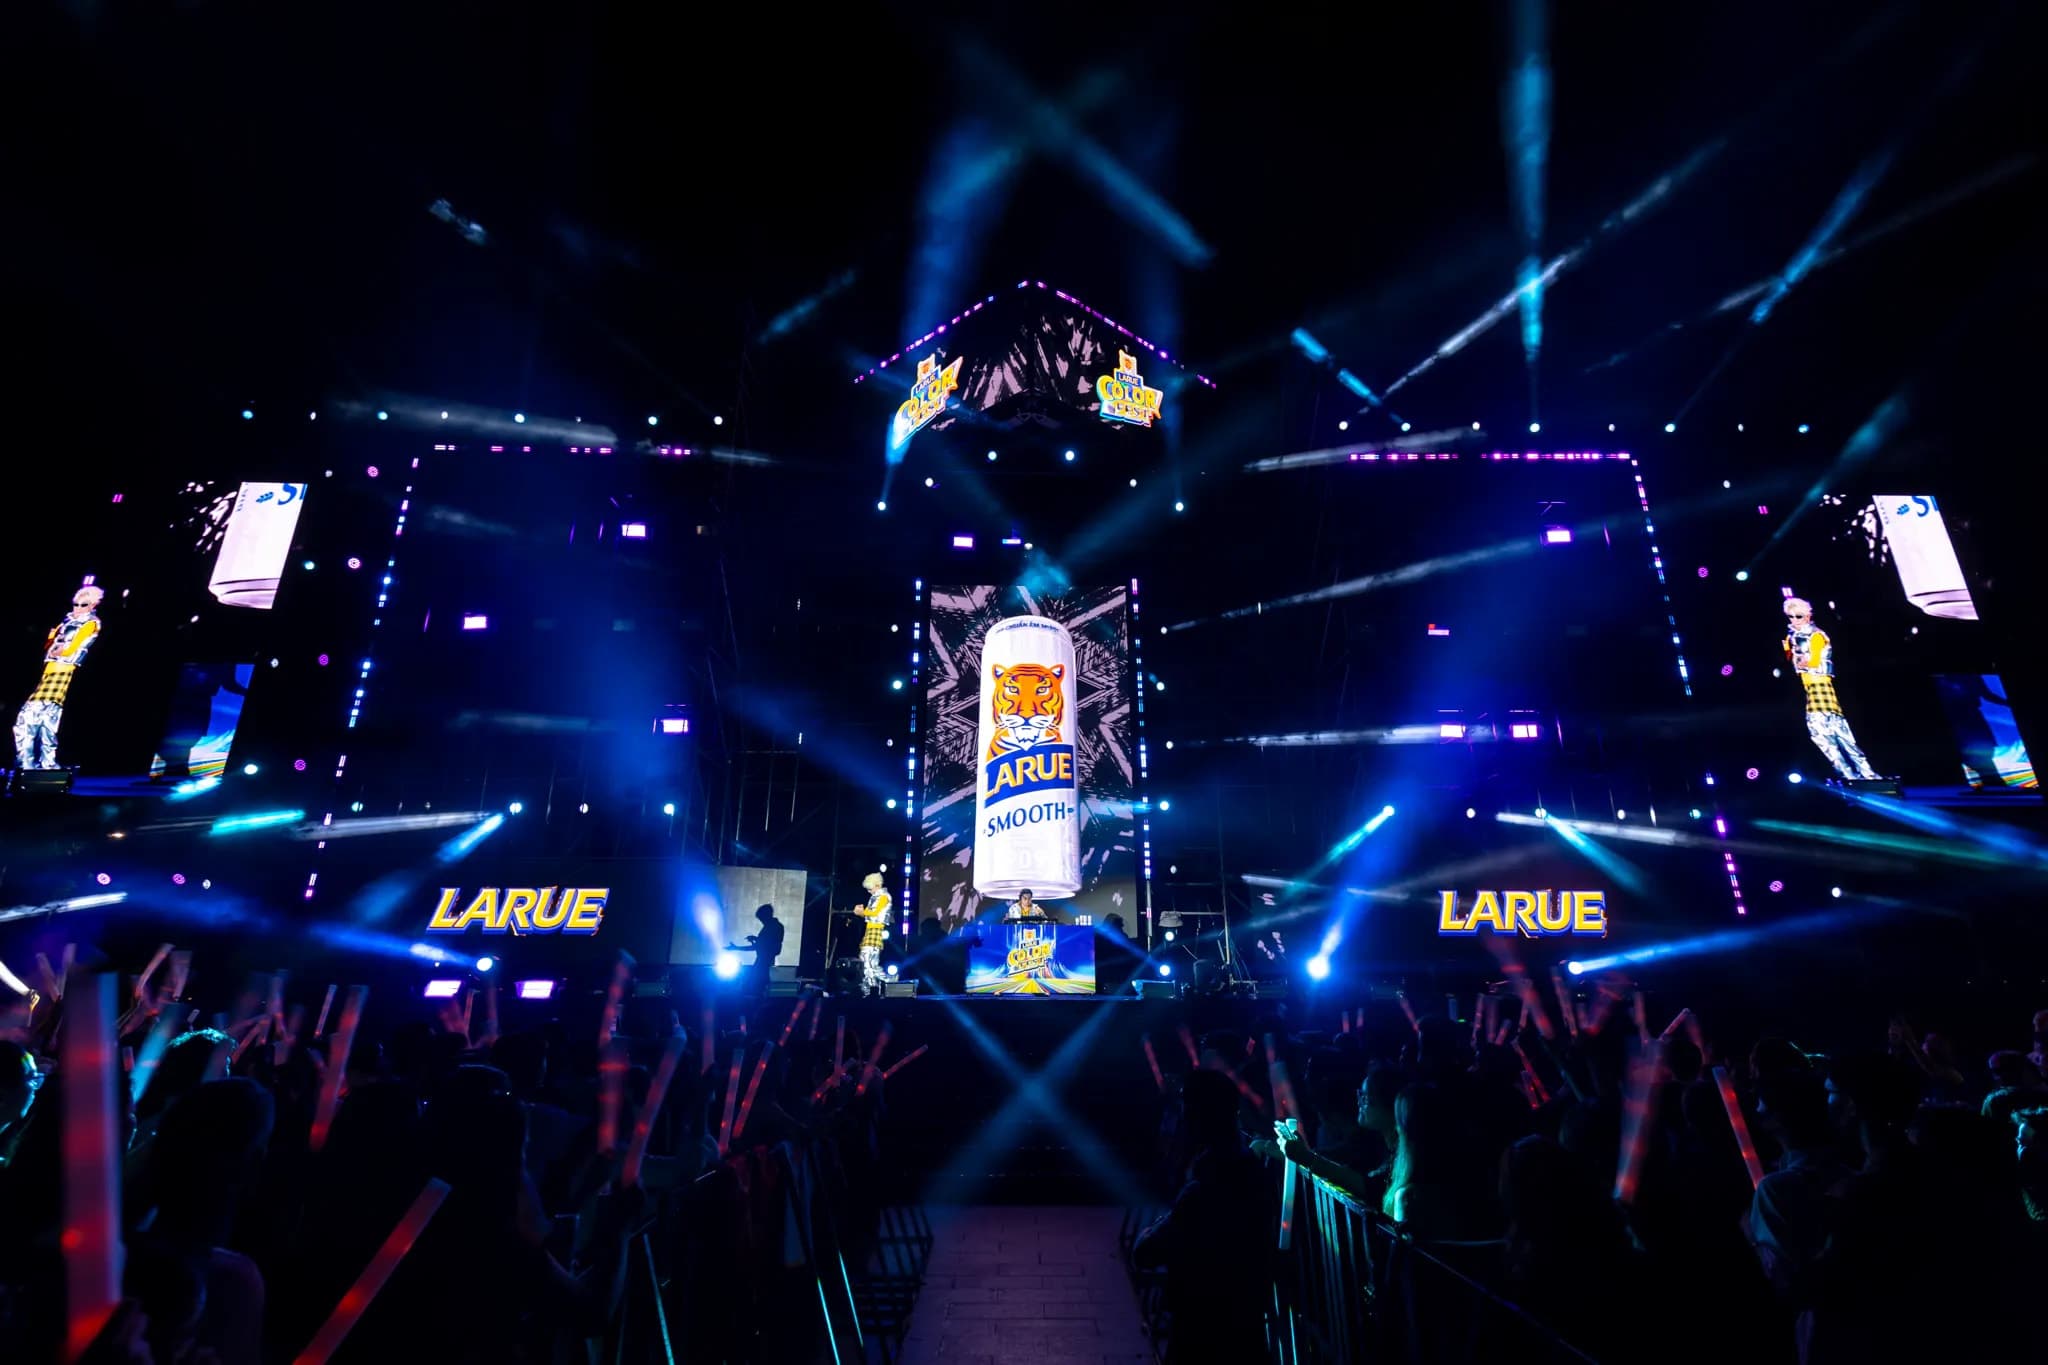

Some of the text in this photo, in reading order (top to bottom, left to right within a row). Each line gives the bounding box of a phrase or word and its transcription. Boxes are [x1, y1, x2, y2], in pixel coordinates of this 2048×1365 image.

[1097, 376, 1156, 409] COLOR
[985, 752, 1072, 798] LARUE
[987, 802, 1065, 837] SMOOTH
[427, 887, 609, 934] LARUE
[1439, 890, 1604, 935] LARUE
